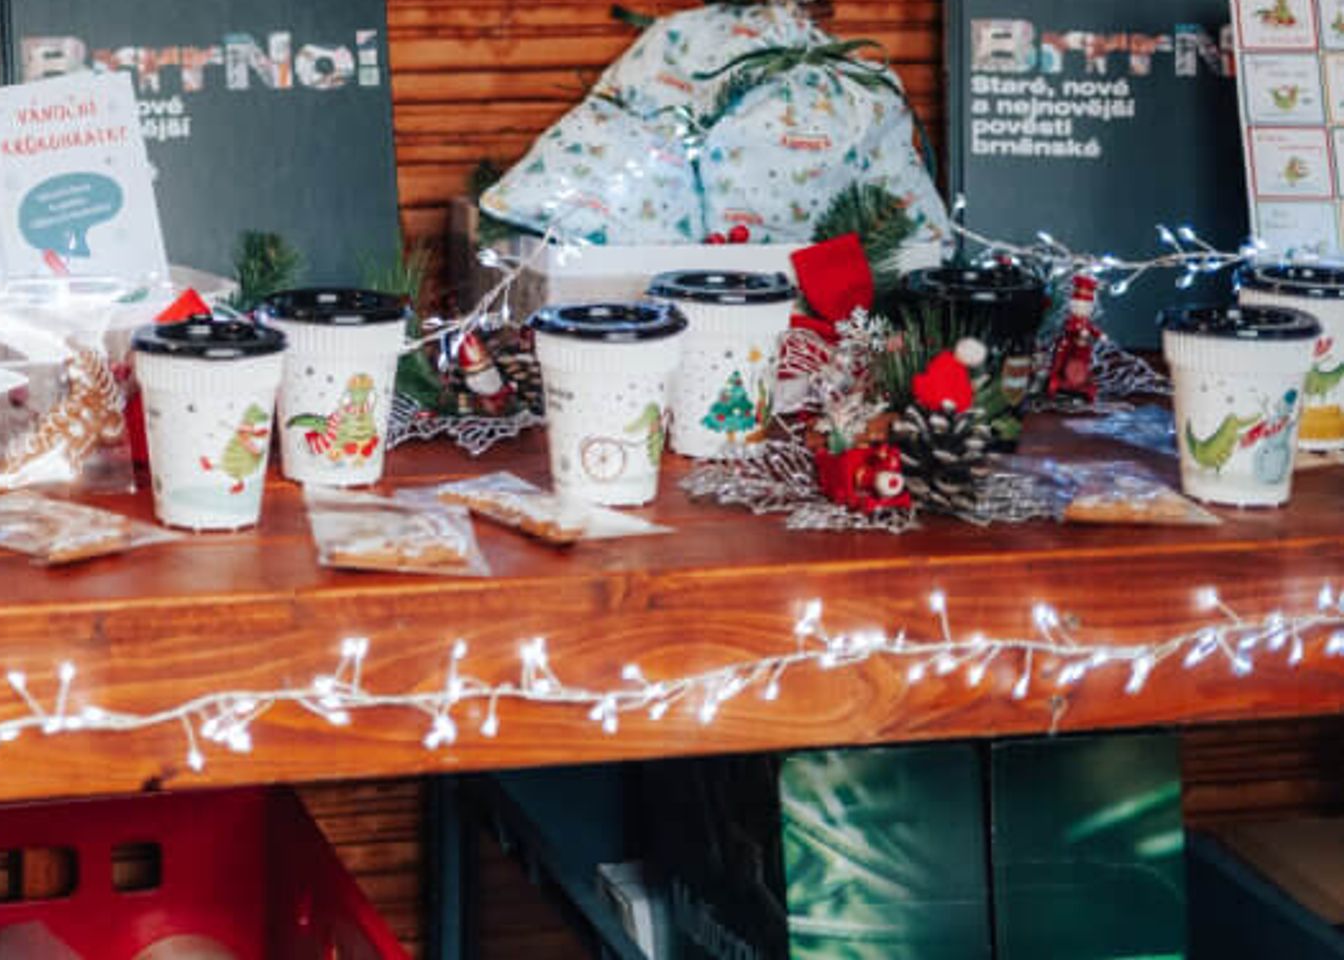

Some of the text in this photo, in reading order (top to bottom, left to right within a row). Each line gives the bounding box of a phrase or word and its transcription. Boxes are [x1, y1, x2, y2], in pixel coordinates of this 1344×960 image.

[970, 75, 1130, 97] Staré, nové
[971, 97, 1136, 122] a nejnovější
[971, 117, 1073, 138] pověsti
[971, 136, 1103, 158] brněnské
